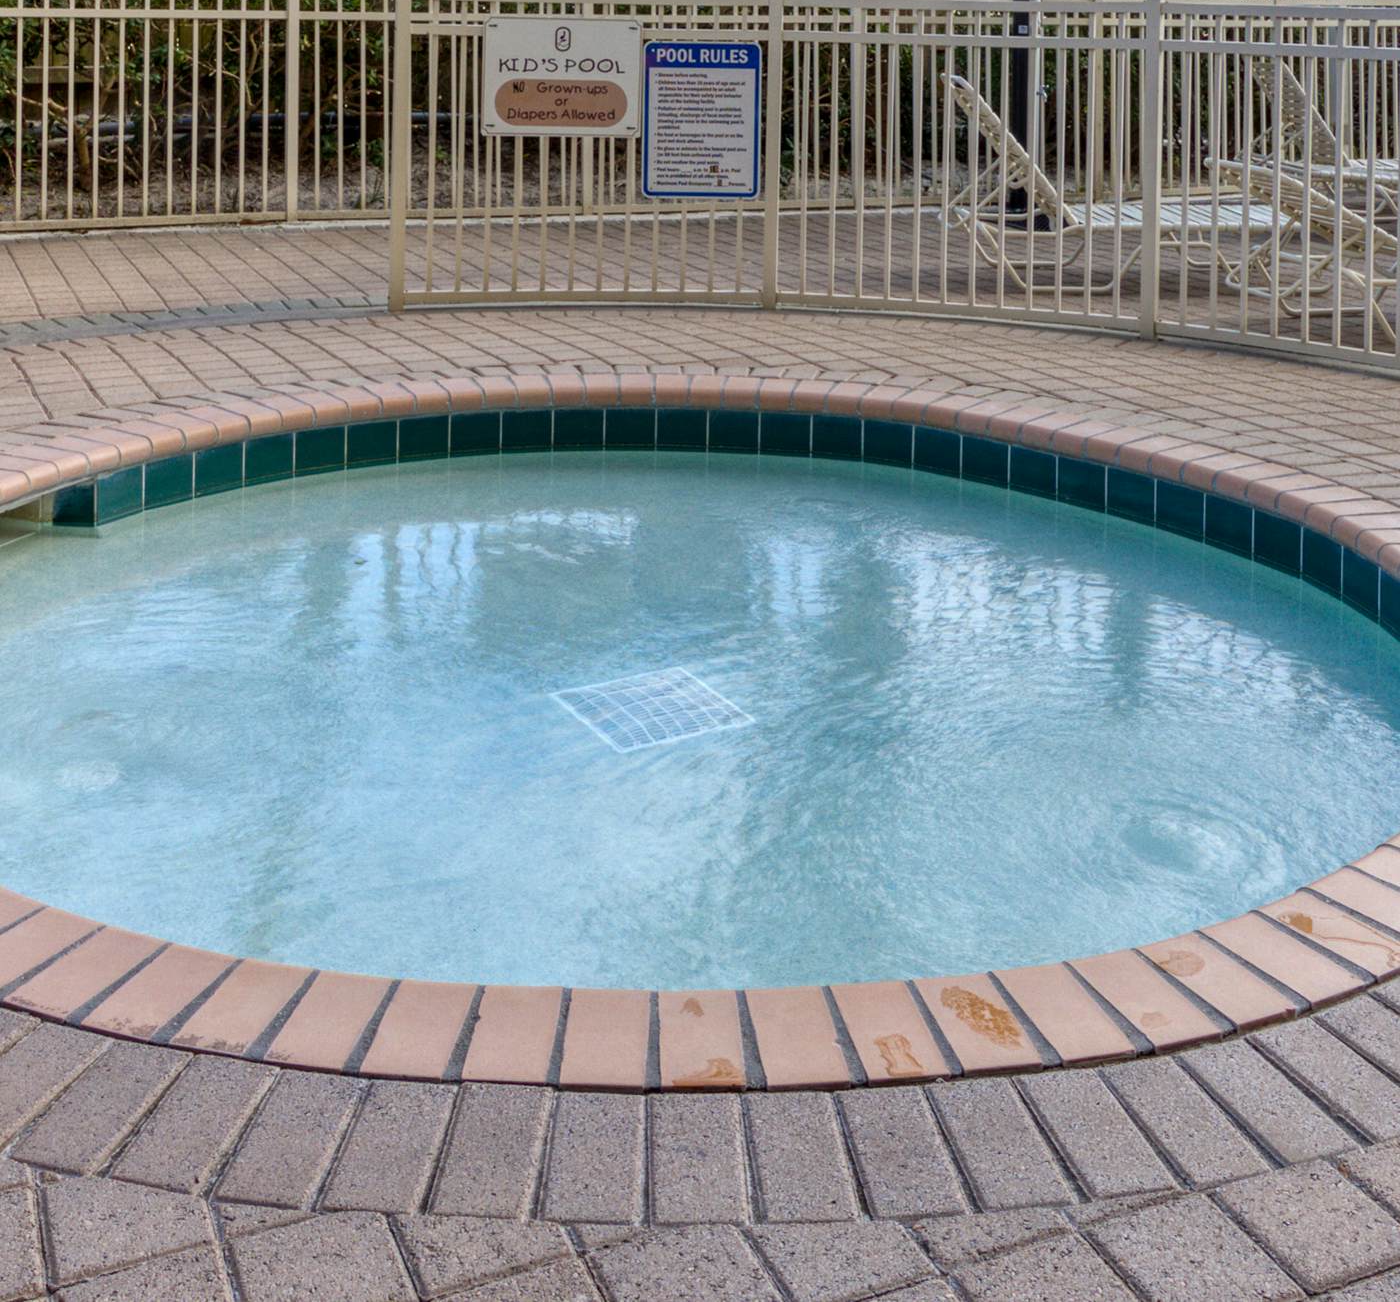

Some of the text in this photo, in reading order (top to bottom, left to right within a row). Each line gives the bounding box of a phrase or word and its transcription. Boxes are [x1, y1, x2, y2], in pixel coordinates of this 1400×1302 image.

[656, 48, 749, 64] POOL RULES
[499, 58, 625, 74] KID'S POOL
[536, 82, 608, 96] Grown-ups
[554, 97, 569, 107] or
[507, 108, 616, 121] Diapers Allowed
